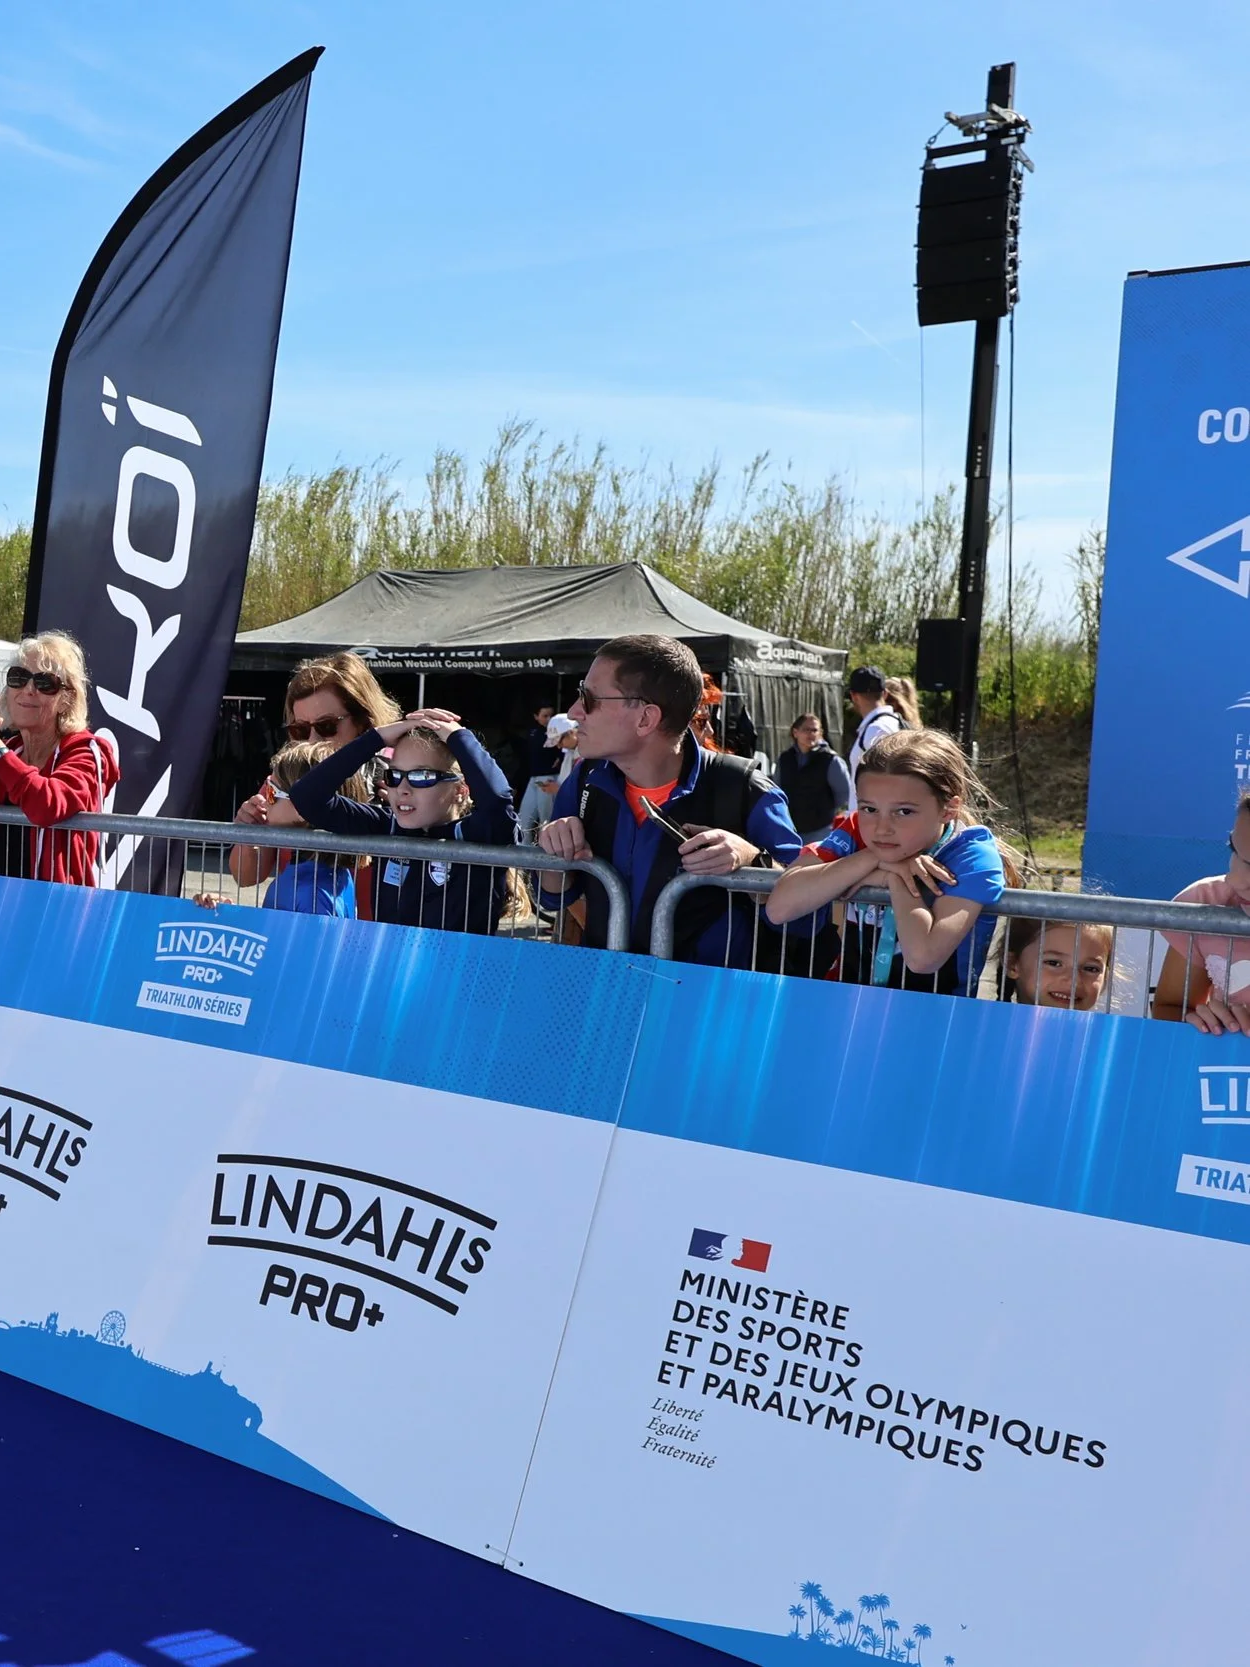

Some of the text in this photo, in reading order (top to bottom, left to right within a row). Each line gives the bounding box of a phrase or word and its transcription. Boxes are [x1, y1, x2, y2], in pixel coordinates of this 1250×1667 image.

[405, 659, 443, 668] Wetsuit
[445, 660, 492, 670] Company
[495, 660, 524, 668] since
[527, 658, 554, 668] 1984
[182, 964, 223, 984] PRO+
[145, 987, 243, 1018] TRIATHLON SÉRIES
[1200, 1078, 1250, 1111] LI
[1194, 1165, 1250, 1195] TRIA
[259, 1263, 385, 1332] PRO+
[679, 1269, 850, 1331] MINISTÈRE
[671, 1300, 864, 1368] DES SPORTS
[650, 1397, 704, 1423] Liberté
[657, 1360, 985, 1472] ET PARALYMPIQUES
[664, 1330, 1108, 1469] ET DES JEUX OLYMPIQUES
[646, 1416, 700, 1443] Égalité
[641, 1436, 718, 1470] Fraternité
